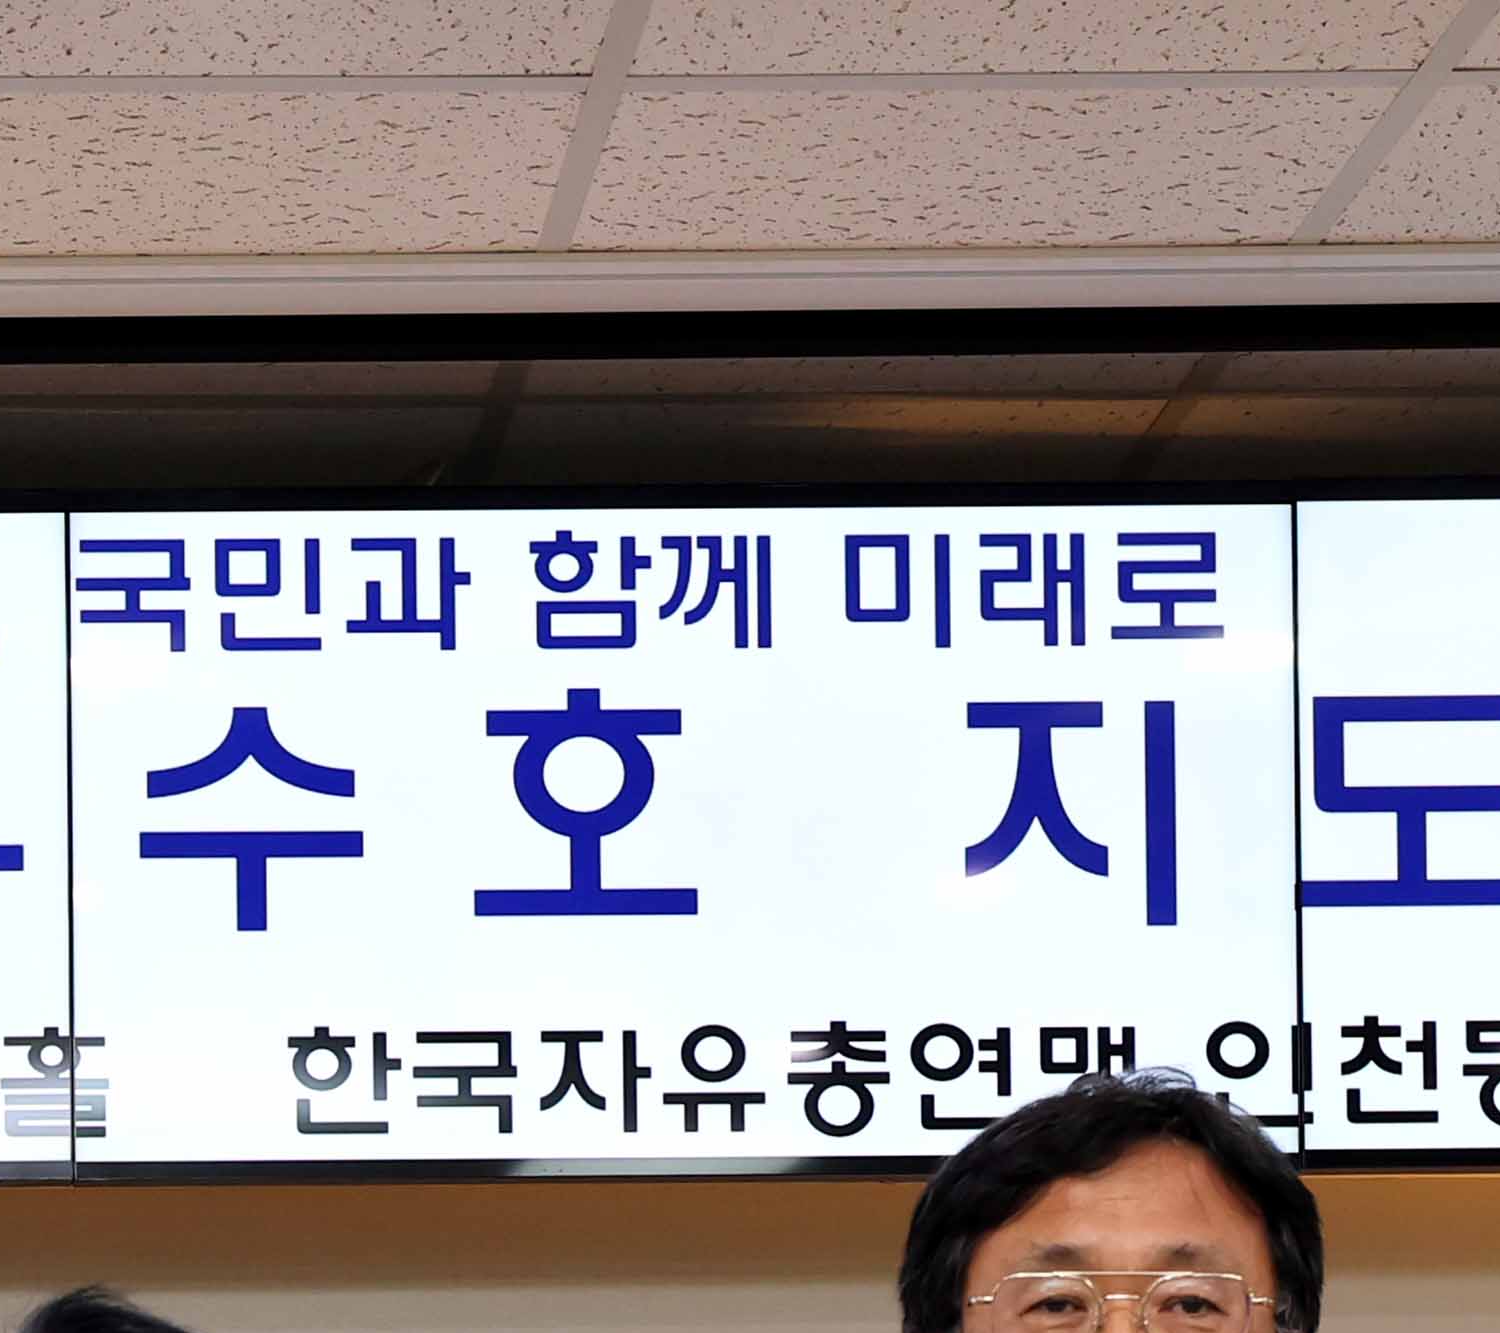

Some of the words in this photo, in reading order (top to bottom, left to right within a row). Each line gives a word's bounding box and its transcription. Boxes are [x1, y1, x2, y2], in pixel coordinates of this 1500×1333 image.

[77, 538, 471, 652] 국민과
[530, 531, 771, 649] 함께
[845, 532, 1223, 648] 미래로
